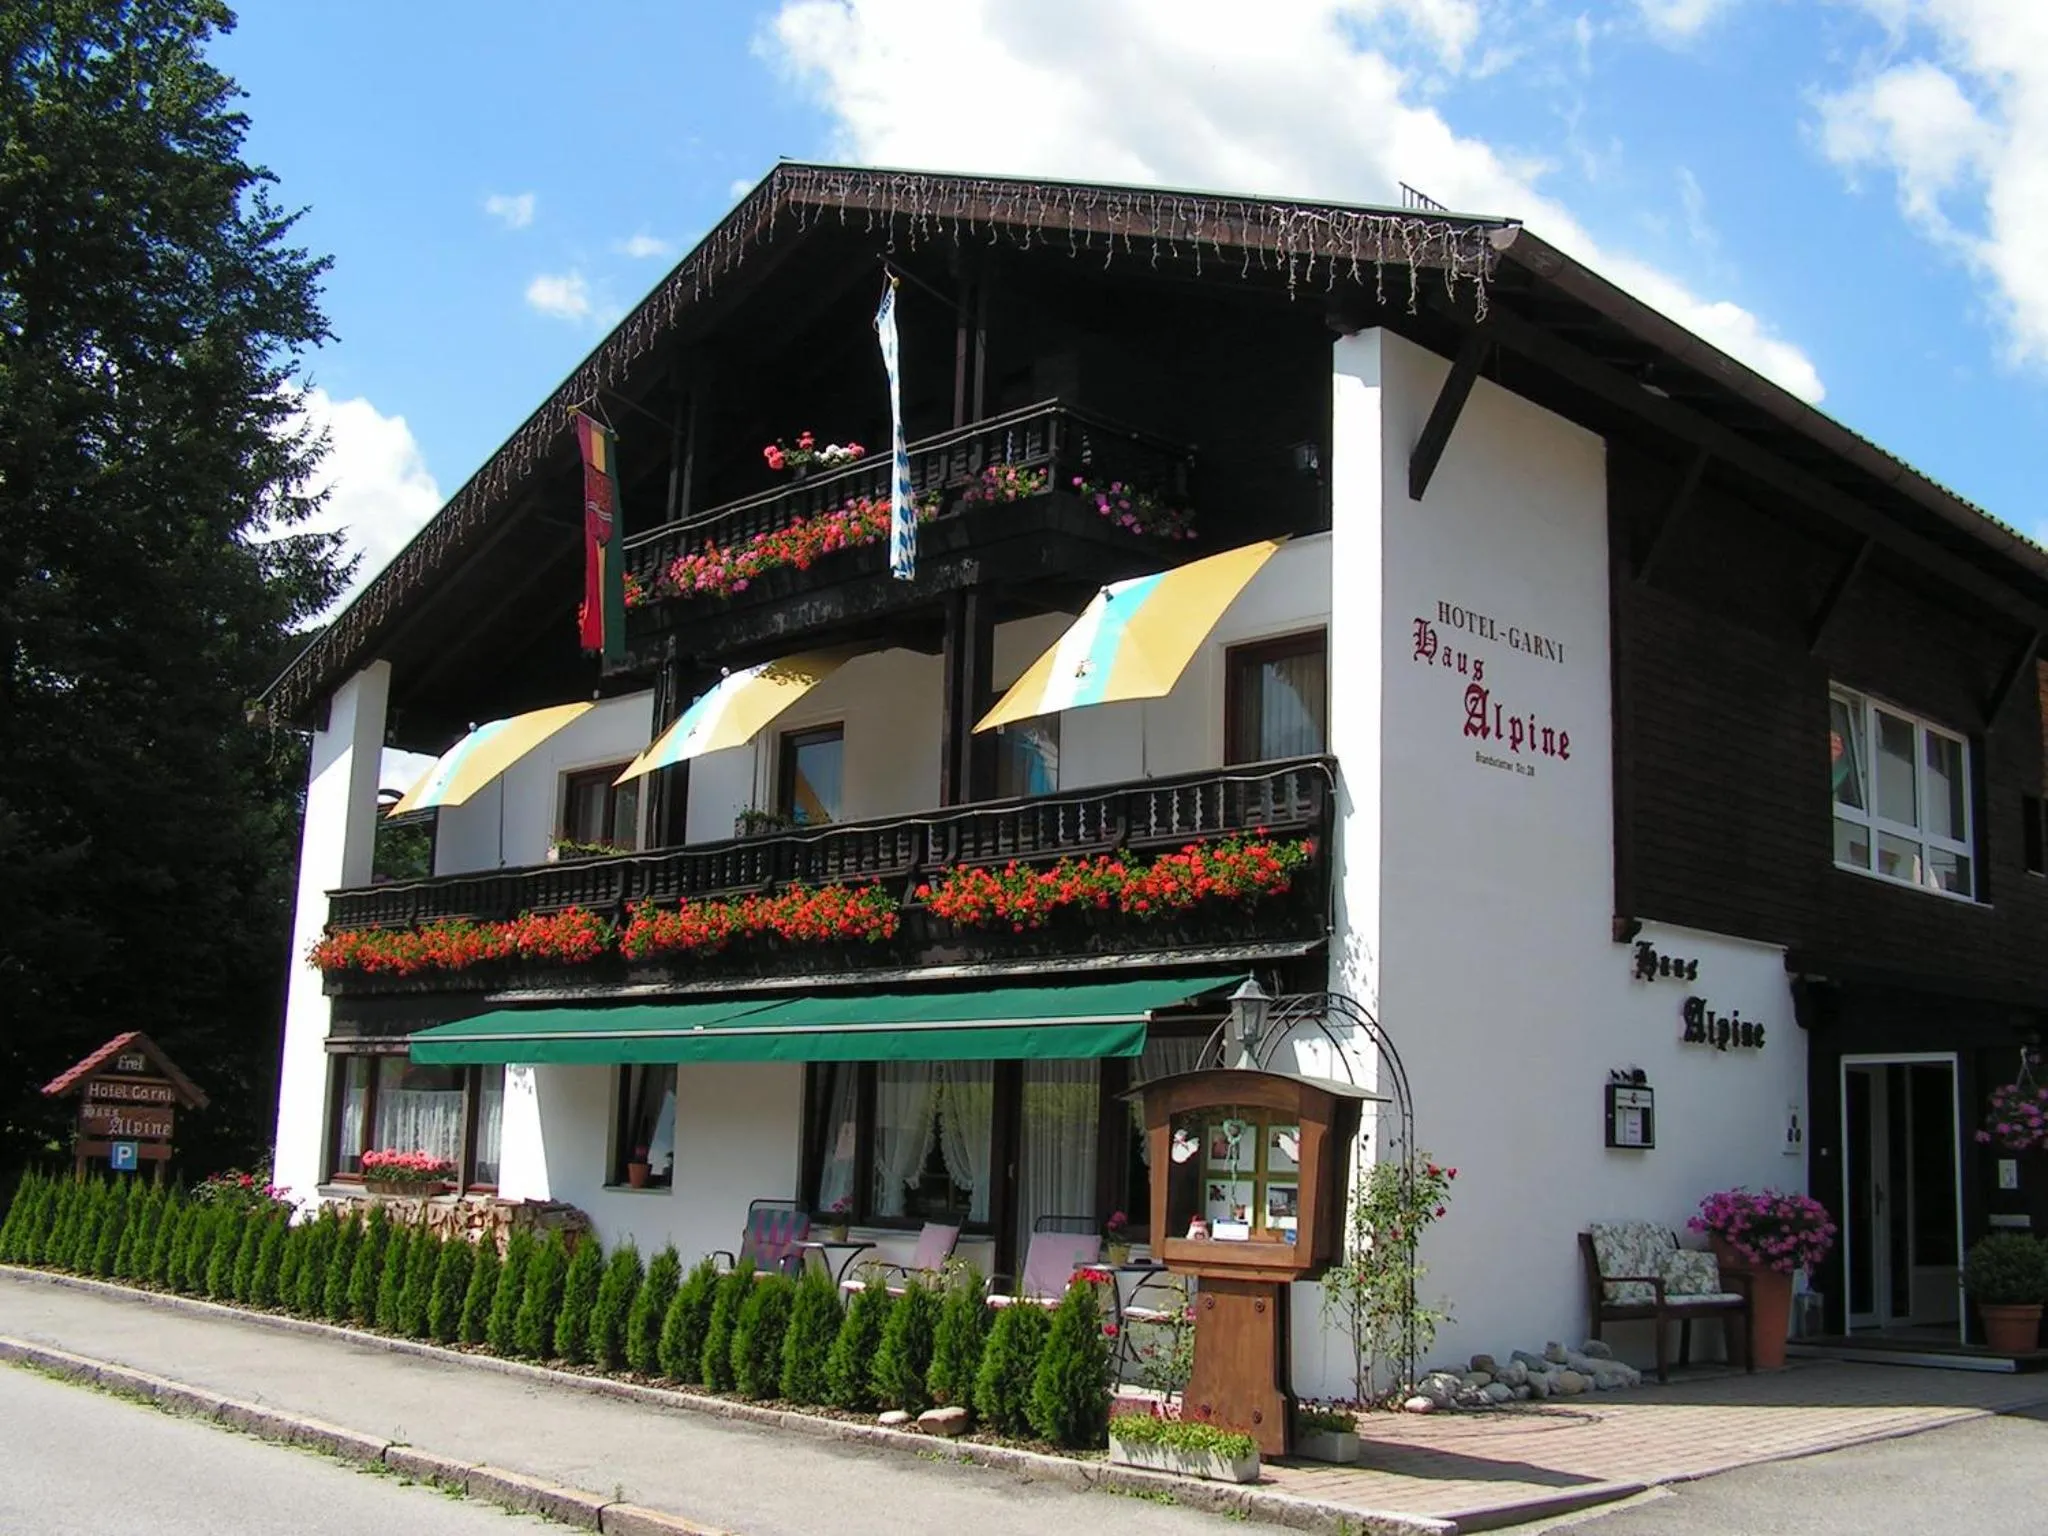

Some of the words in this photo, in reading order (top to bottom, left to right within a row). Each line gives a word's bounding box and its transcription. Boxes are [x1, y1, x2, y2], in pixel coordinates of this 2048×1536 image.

[1413, 617, 1485, 681] Haus
[1437, 600, 1564, 664] HOTEL-GARNI
[1463, 682, 1571, 760] Alpine
[1634, 940, 1699, 982] Haus
[1683, 996, 1766, 1052] Alpine
[89, 1082, 128, 1098] Hotel
[108, 1117, 172, 1136] Alpine
[117, 1146, 132, 1165] P
